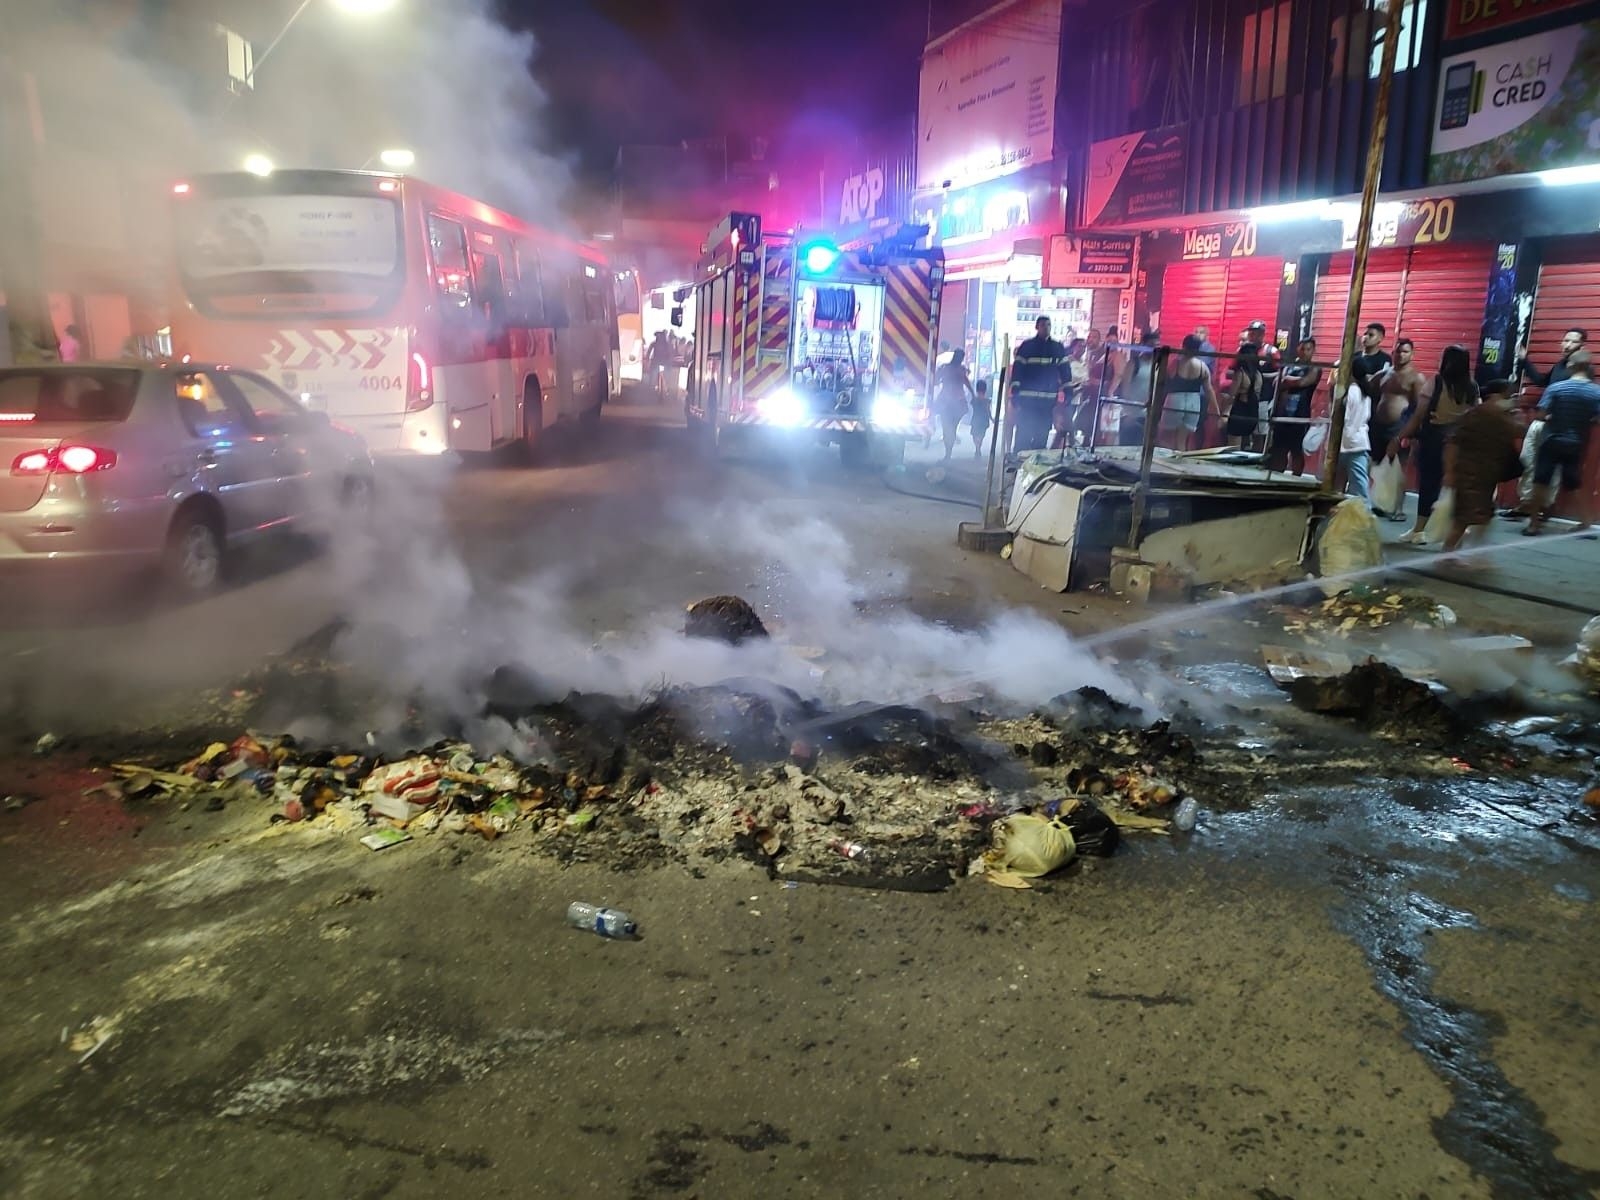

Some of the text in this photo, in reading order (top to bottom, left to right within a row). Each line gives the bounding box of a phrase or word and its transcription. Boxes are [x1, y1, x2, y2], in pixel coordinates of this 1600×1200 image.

[1493, 80, 1546, 107] CRED
[1183, 229, 1221, 259] Mega
[359, 375, 402, 391] 4004
